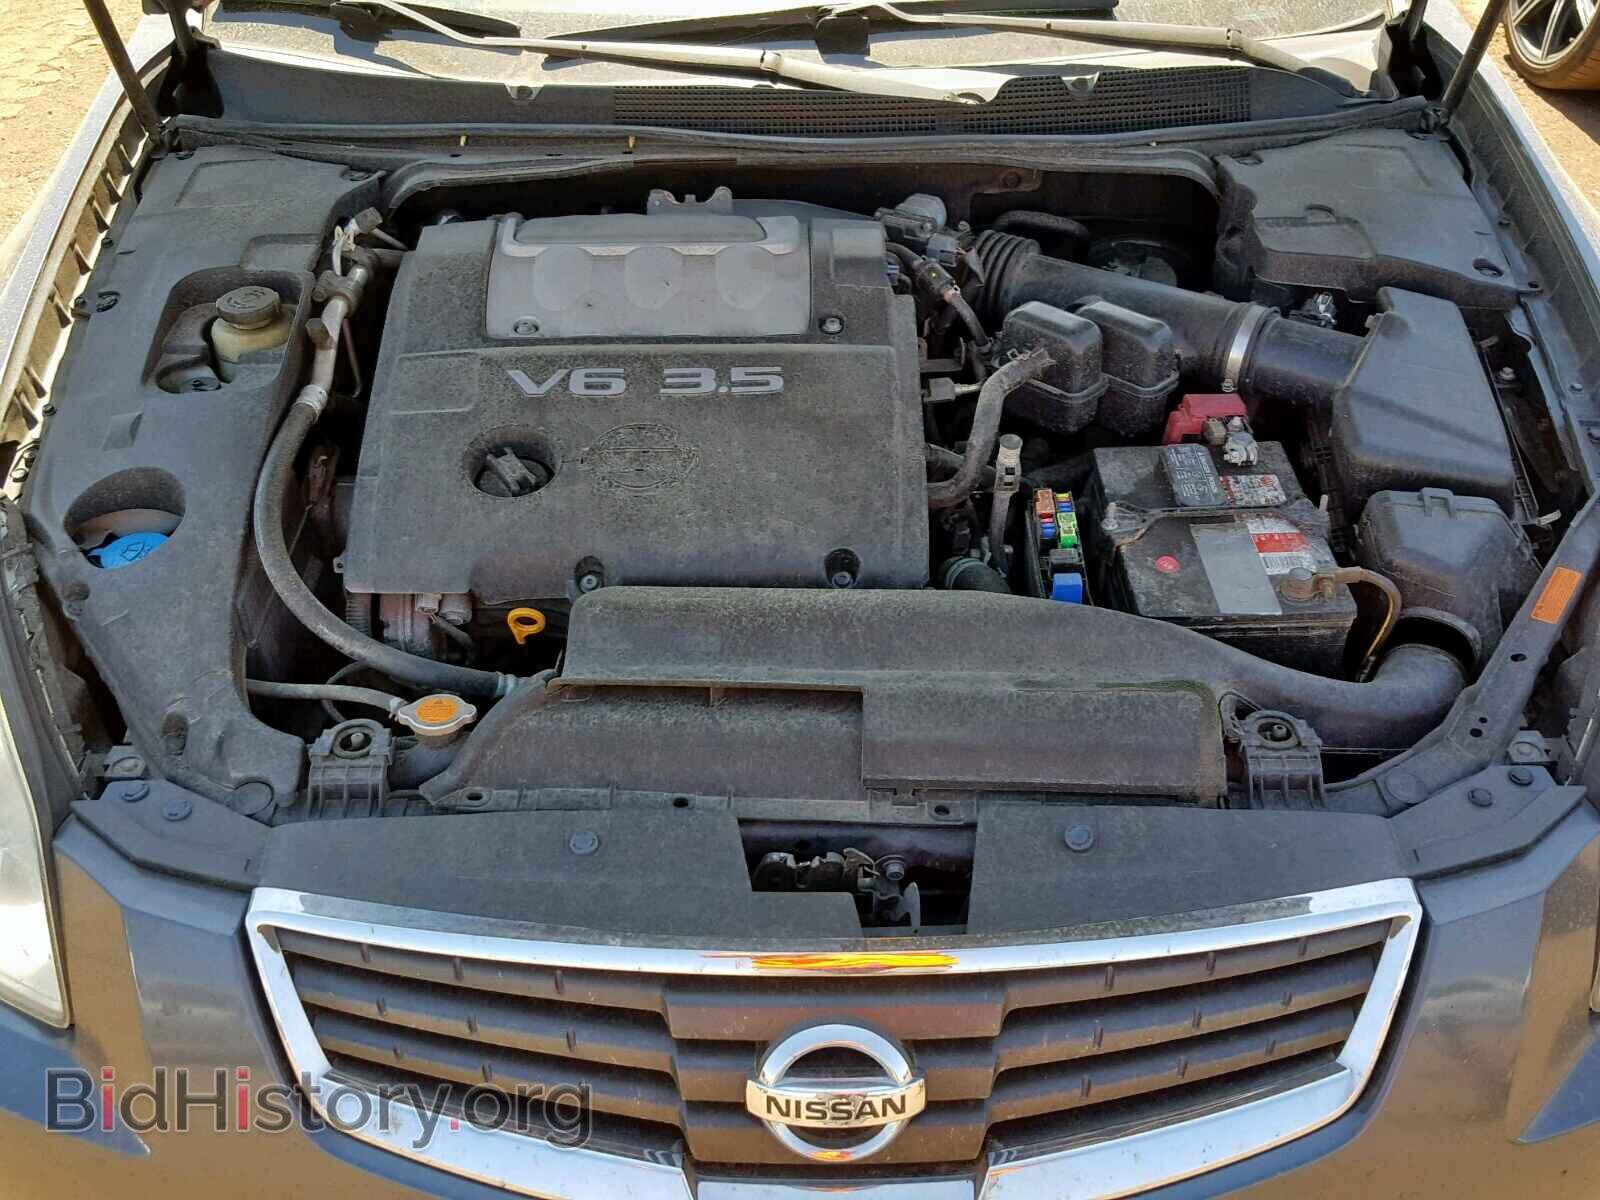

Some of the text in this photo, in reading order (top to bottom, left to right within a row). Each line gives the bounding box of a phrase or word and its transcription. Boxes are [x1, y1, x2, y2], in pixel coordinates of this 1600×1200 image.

[507, 366, 785, 397] V6 3.5
[766, 1094, 907, 1121] NISSAN
